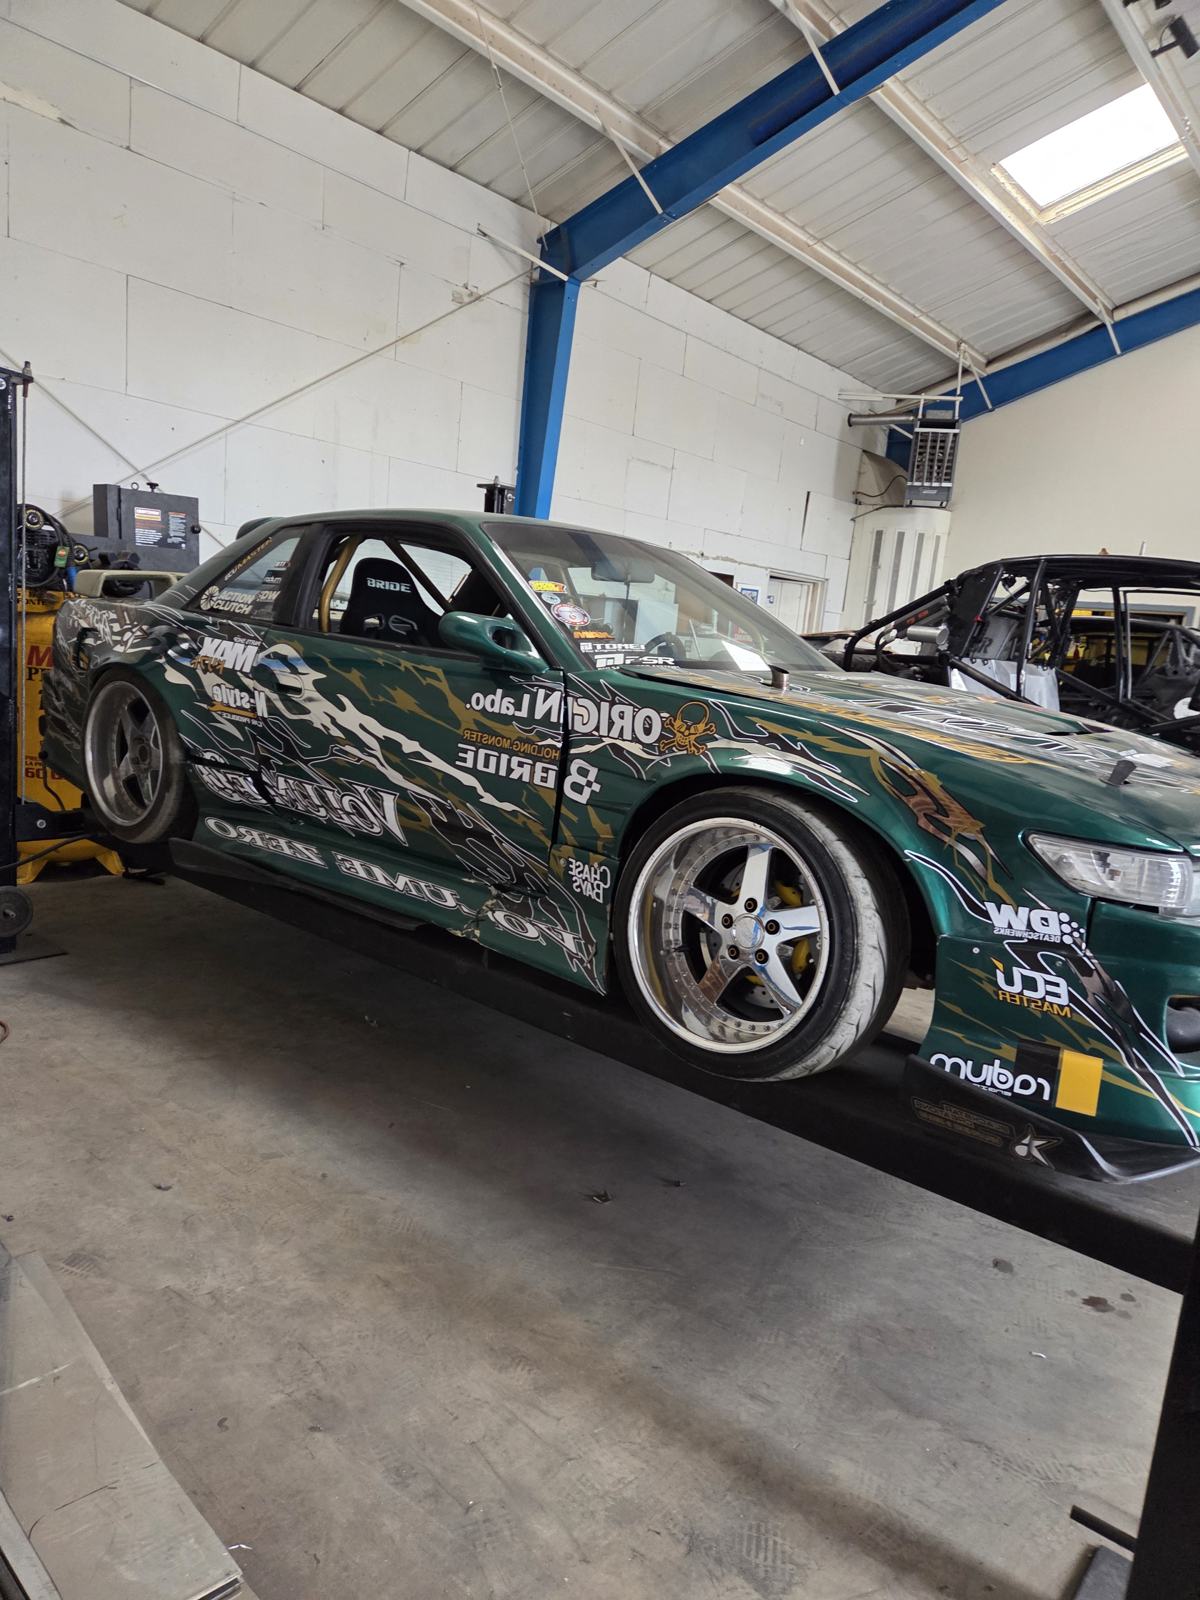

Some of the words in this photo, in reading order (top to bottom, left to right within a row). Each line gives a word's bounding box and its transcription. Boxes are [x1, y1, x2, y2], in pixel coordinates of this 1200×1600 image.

[366, 577, 412, 593] BRIDE
[218, 590, 255, 604] ACTION
[213, 600, 253, 615] CLUTCH
